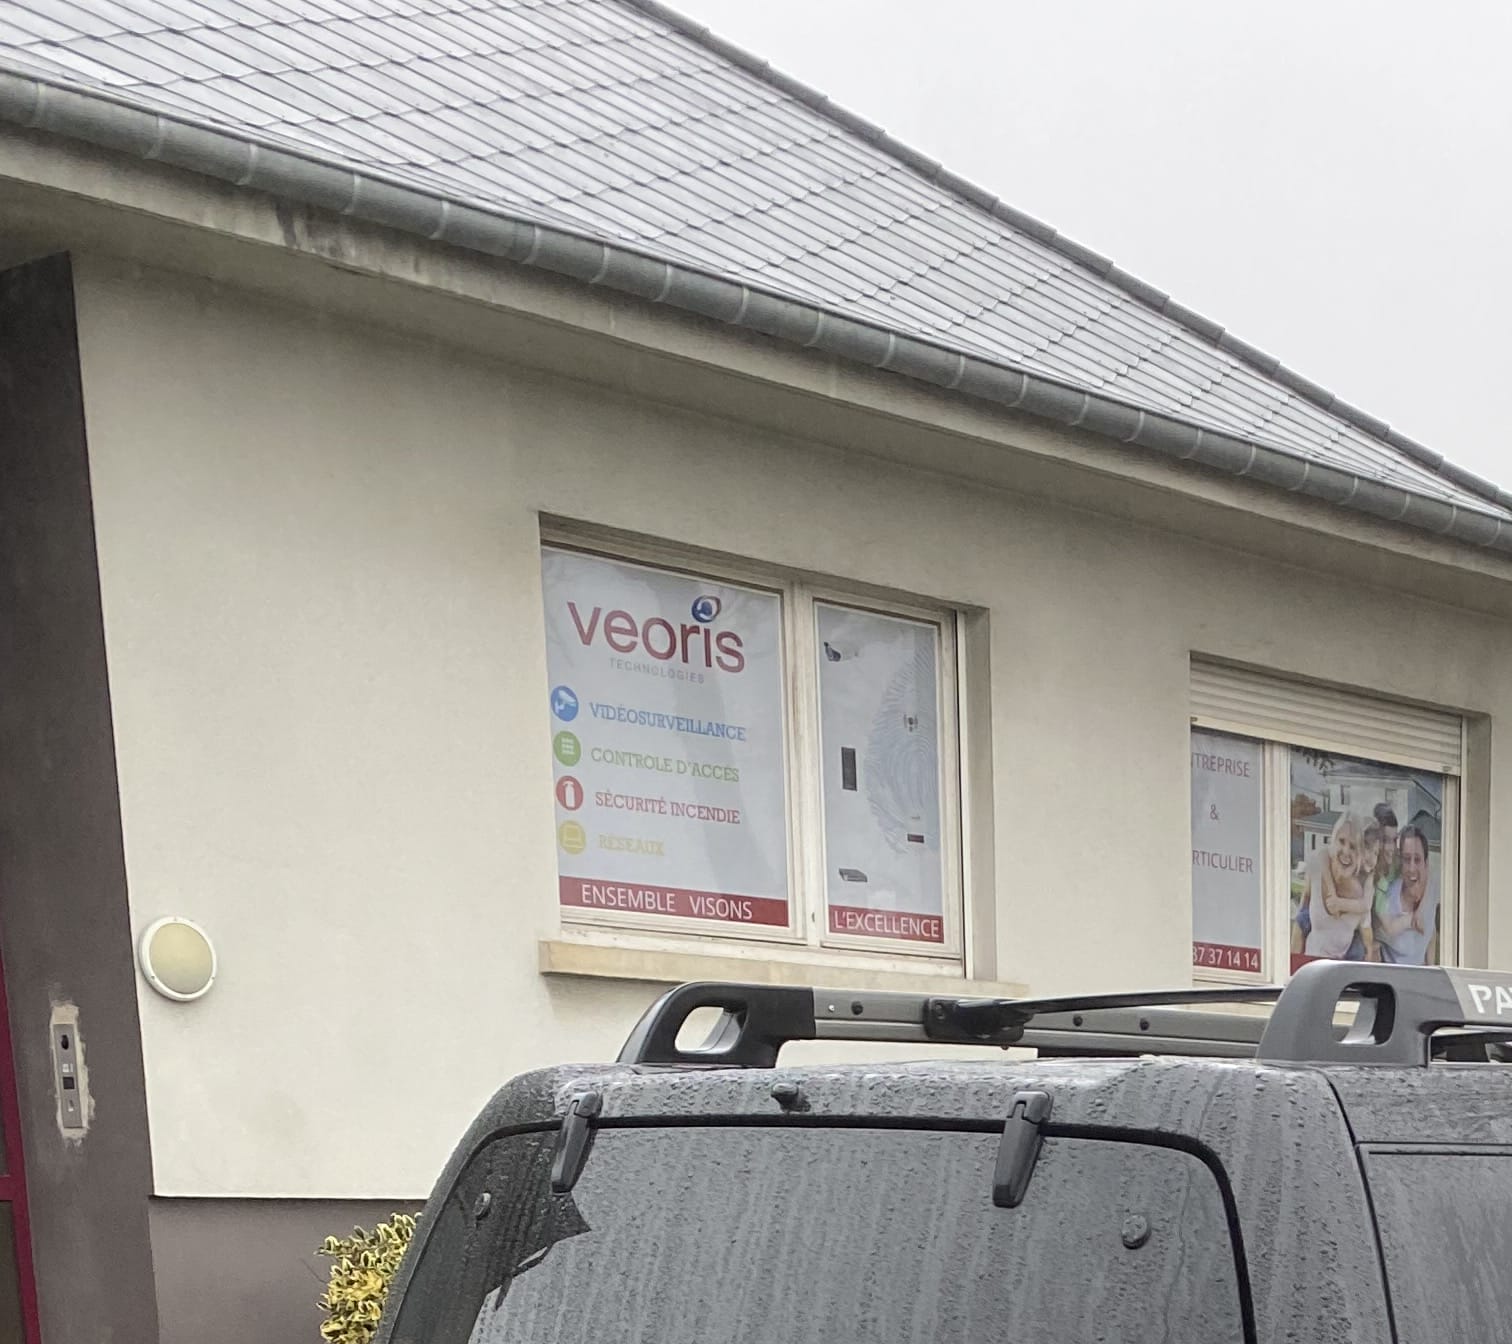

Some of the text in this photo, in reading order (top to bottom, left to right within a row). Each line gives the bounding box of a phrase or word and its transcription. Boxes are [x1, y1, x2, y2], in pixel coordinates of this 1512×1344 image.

[567, 601, 745, 673] veoris
[609, 657, 705, 685] TECHNOLOGIES
[589, 702, 747, 742] VIDÉOSURVEILLANCE
[595, 788, 741, 825] SÉCURITÉ INCENDIE
[1209, 803, 1219, 821] &
[581, 884, 752, 921] ENSEMBLE VISONS
[834, 910, 940, 938] L'EXCELLENCE
[1208, 947, 1224, 966] 37
[1226, 950, 1241, 968] 14
[1243, 951, 1259, 970] 14
